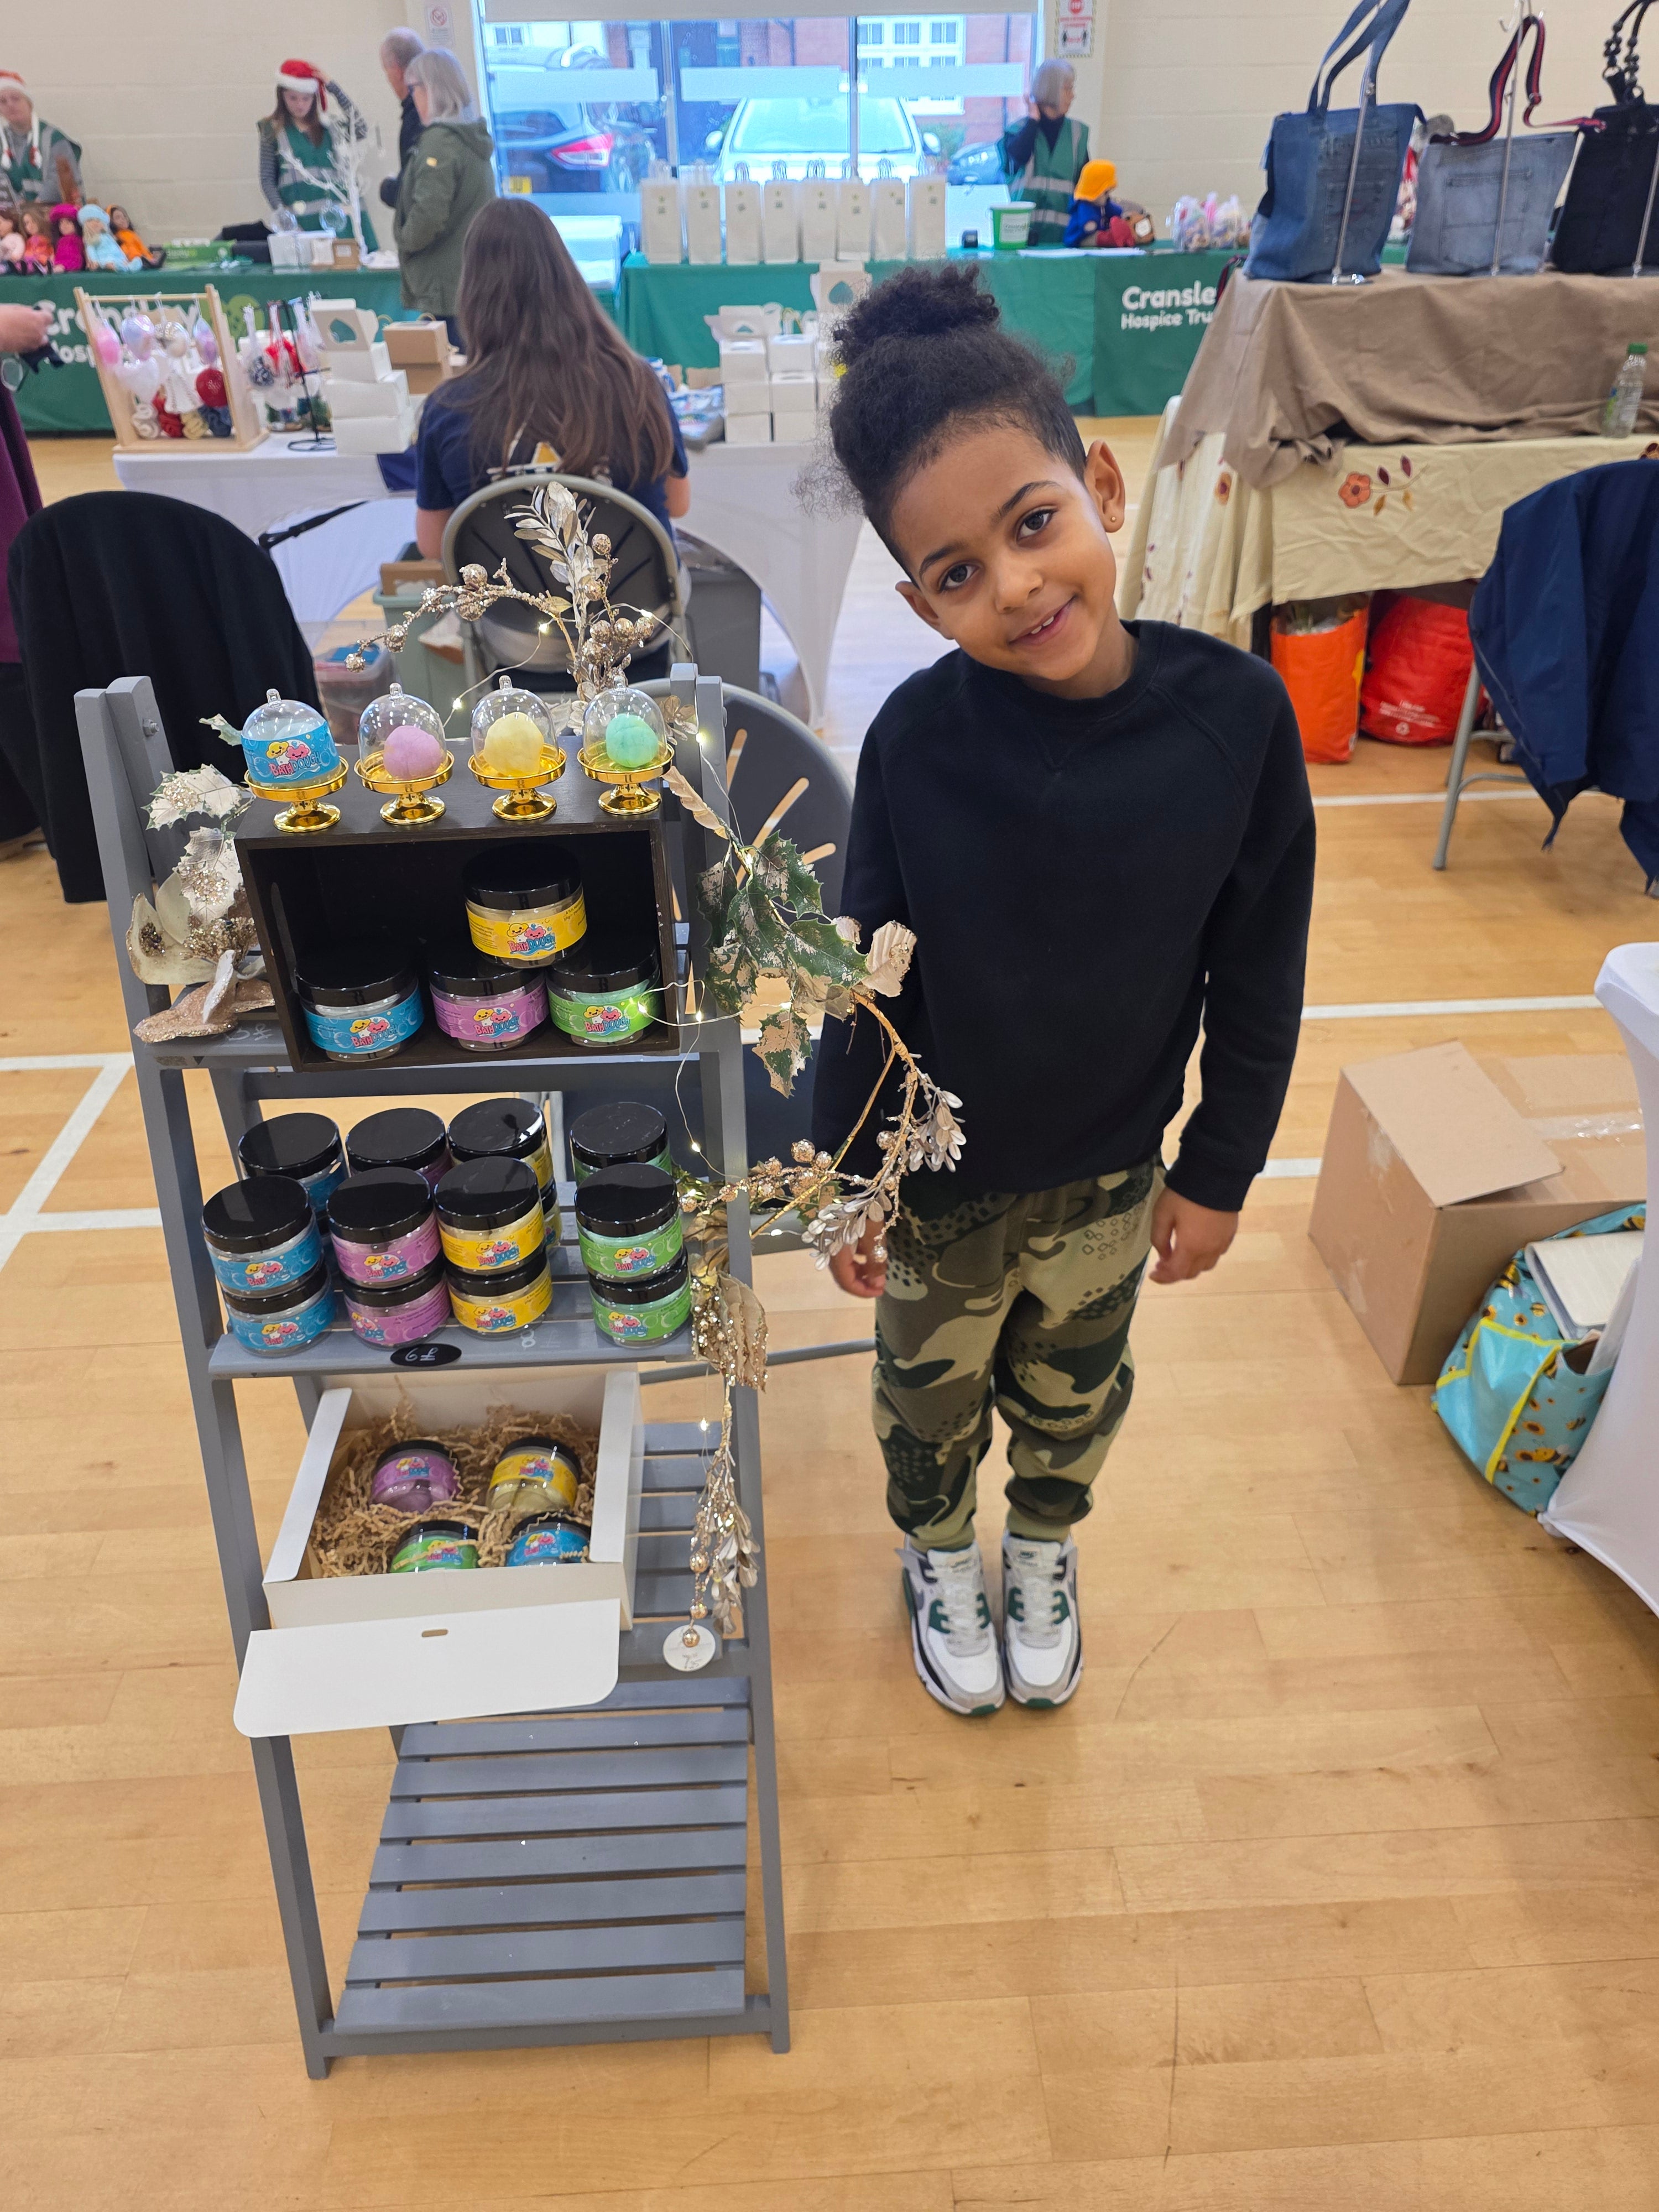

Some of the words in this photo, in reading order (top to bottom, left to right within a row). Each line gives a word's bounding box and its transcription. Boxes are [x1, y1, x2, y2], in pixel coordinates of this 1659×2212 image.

[1121, 280, 1217, 311] Cransle
[1121, 310, 1183, 332] Hospice
[1185, 307, 1213, 326] Tru
[268, 763, 294, 776] BATH
[290, 752, 322, 772] DOUGH
[507, 940, 529, 952] BATH
[527, 932, 556, 951] DOUGH
[473, 1024, 494, 1035] BATH
[492, 1016, 519, 1032] DOUGH
[584, 1021, 604, 1032] BATH
[602, 1016, 630, 1032] DOUGH
[351, 1035, 373, 1047] BATH
[371, 1025, 399, 1041] DOUGH
